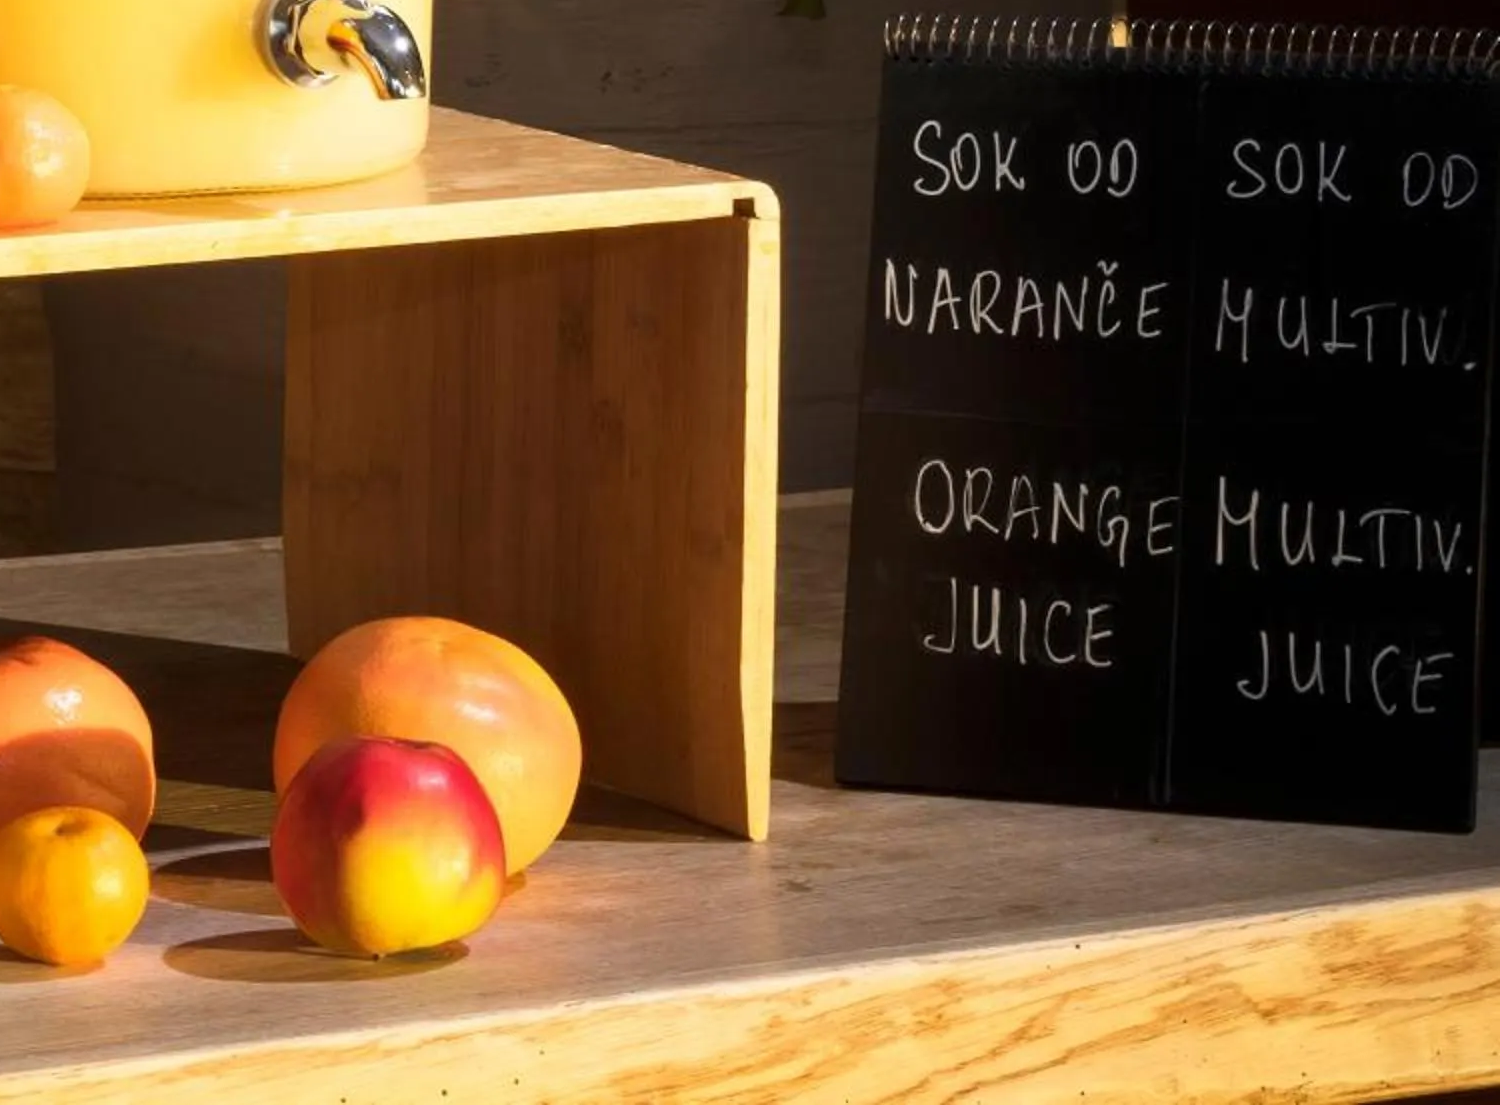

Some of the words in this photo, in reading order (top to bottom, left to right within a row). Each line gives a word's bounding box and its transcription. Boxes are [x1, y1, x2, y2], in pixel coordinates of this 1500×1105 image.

[914, 120, 1025, 195] SOK
[1068, 139, 1137, 197] OD
[1227, 139, 1351, 201] SOK
[1404, 153, 1475, 208] OD
[885, 258, 1167, 340] NARANČE
[1216, 279, 1474, 369] MULTIV.
[914, 459, 1178, 567] ORANGE
[1216, 477, 1473, 574] MULTIV.
[924, 577, 1112, 666] JUICE
[1238, 632, 1452, 714] JUICE
